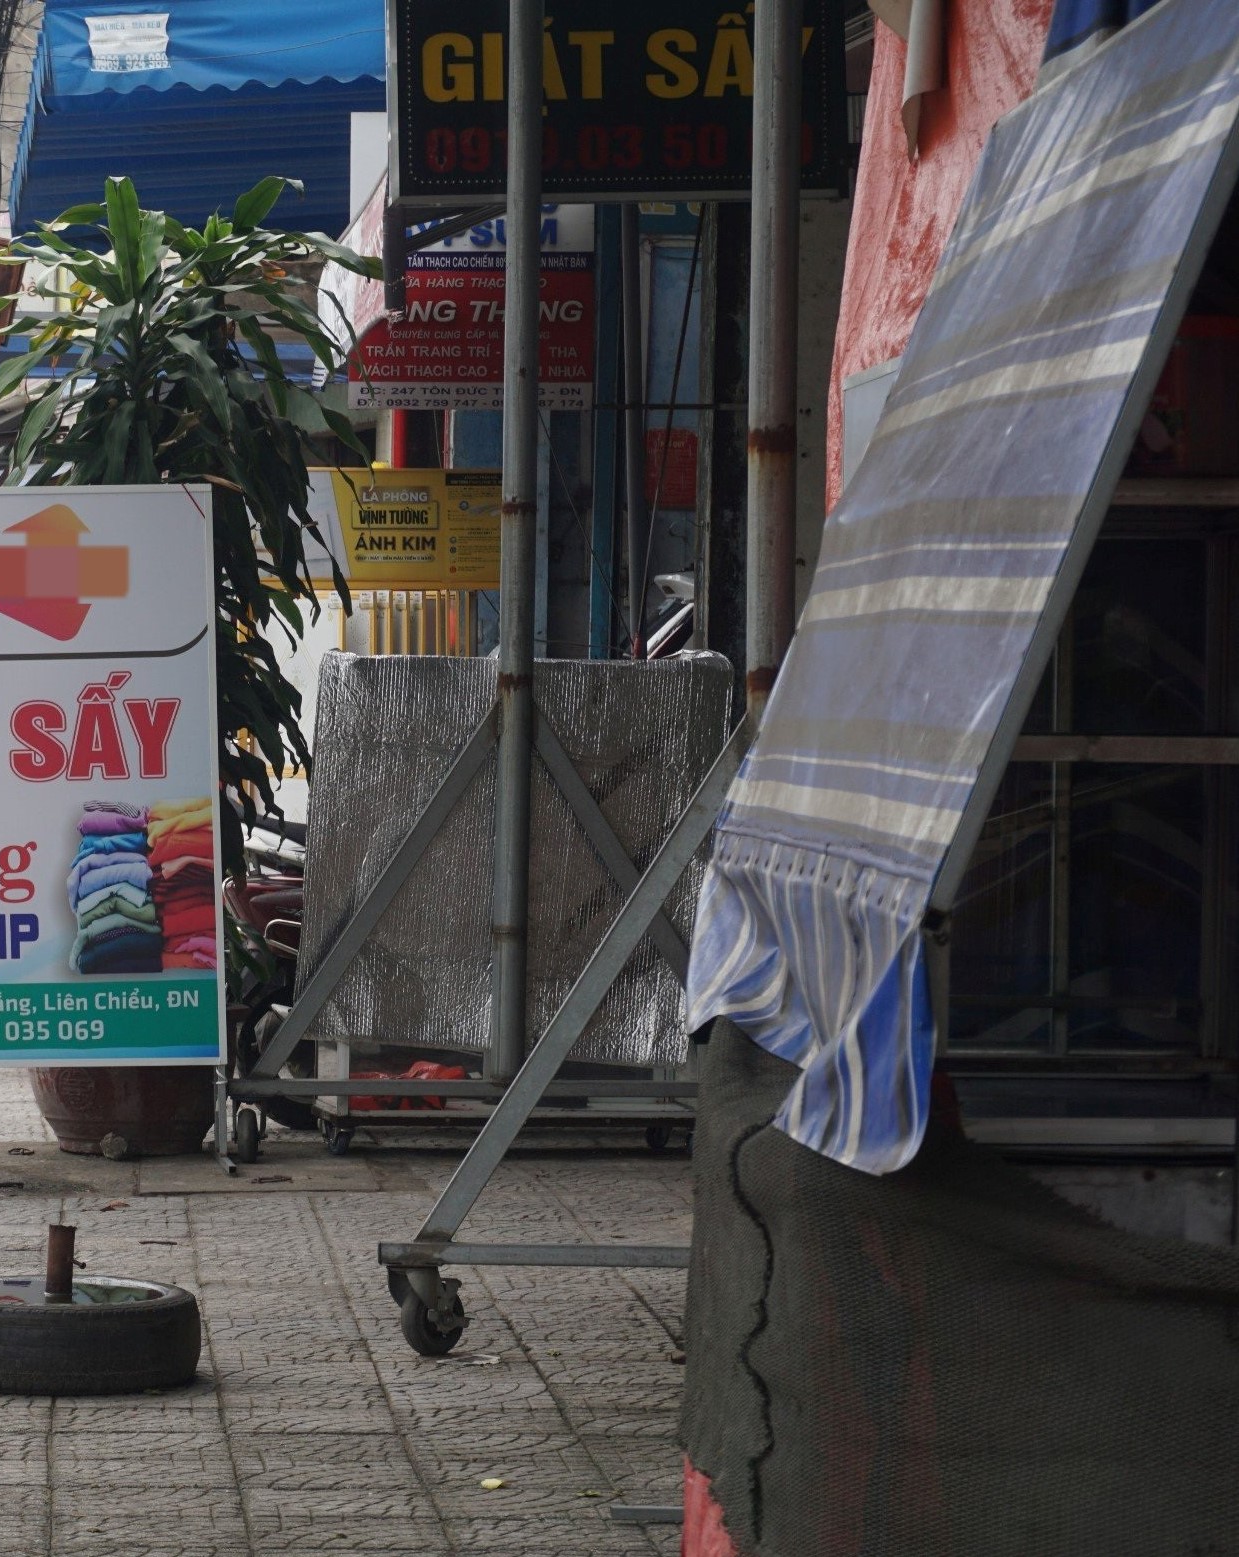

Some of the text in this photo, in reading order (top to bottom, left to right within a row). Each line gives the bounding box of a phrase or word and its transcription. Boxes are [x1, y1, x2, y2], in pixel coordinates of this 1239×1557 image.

[646, 2, 815, 99] SẤ
[426, 257, 452, 270] THẠCH
[453, 257, 469, 268] CAO
[470, 253, 493, 268] CHIẾM
[426, 276, 464, 288] HÀNG
[471, 277, 507, 289] THẠC
[405, 299, 584, 323] NG THNG
[411, 345, 461, 357] TRANG
[404, 365, 452, 378] THẠCH
[457, 365, 487, 377] CAO
[391, 387, 415, 395] 247
[421, 385, 450, 395] TÔN
[383, 488, 428, 502] PHÔNG
[389, 506, 428, 525] TƯỜNG
[355, 532, 436, 551] ÁNH KIM
[9, 670, 182, 783] SẤY
[44, 990, 89, 1011] Liên
[94, 987, 161, 1012] Chiểu,
[167, 990, 200, 1009] ĐN
[4, 1020, 50, 1042] 035
[58, 1019, 105, 1041] 069
